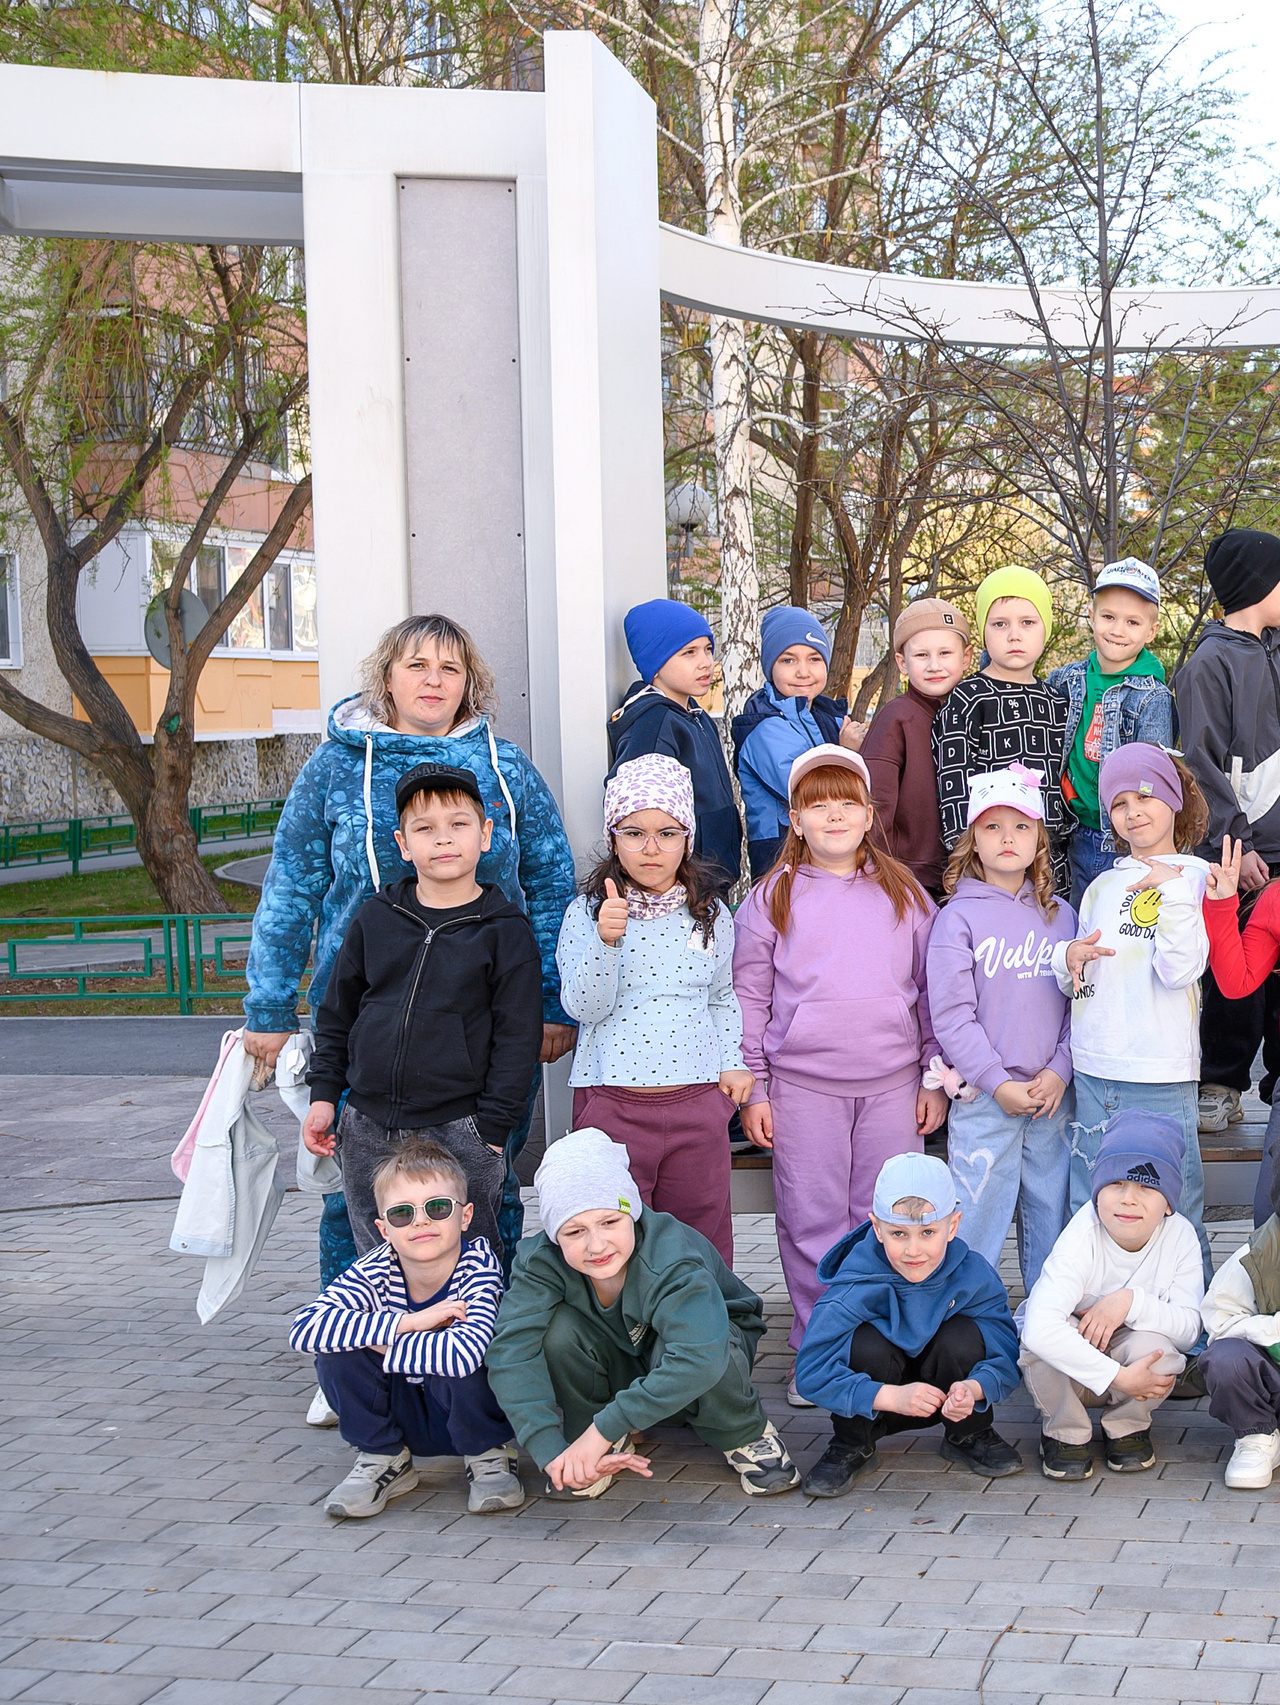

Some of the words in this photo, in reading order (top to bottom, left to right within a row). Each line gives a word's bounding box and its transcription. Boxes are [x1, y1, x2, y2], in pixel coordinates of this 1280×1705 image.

[1038, 704, 1045, 714] U
[952, 714, 958, 725] E
[1013, 711, 1020, 719] 5
[1003, 737, 1011, 748] K
[1031, 736, 1037, 746] E
[948, 747, 956, 758] D
[945, 780, 953, 791] D
[1119, 887, 1142, 915] TODA
[1119, 922, 1144, 938] GOOD
[1143, 927, 1156, 940] DA
[974, 929, 1053, 979] Vulp
[1126, 1173, 1160, 1186] adidas
